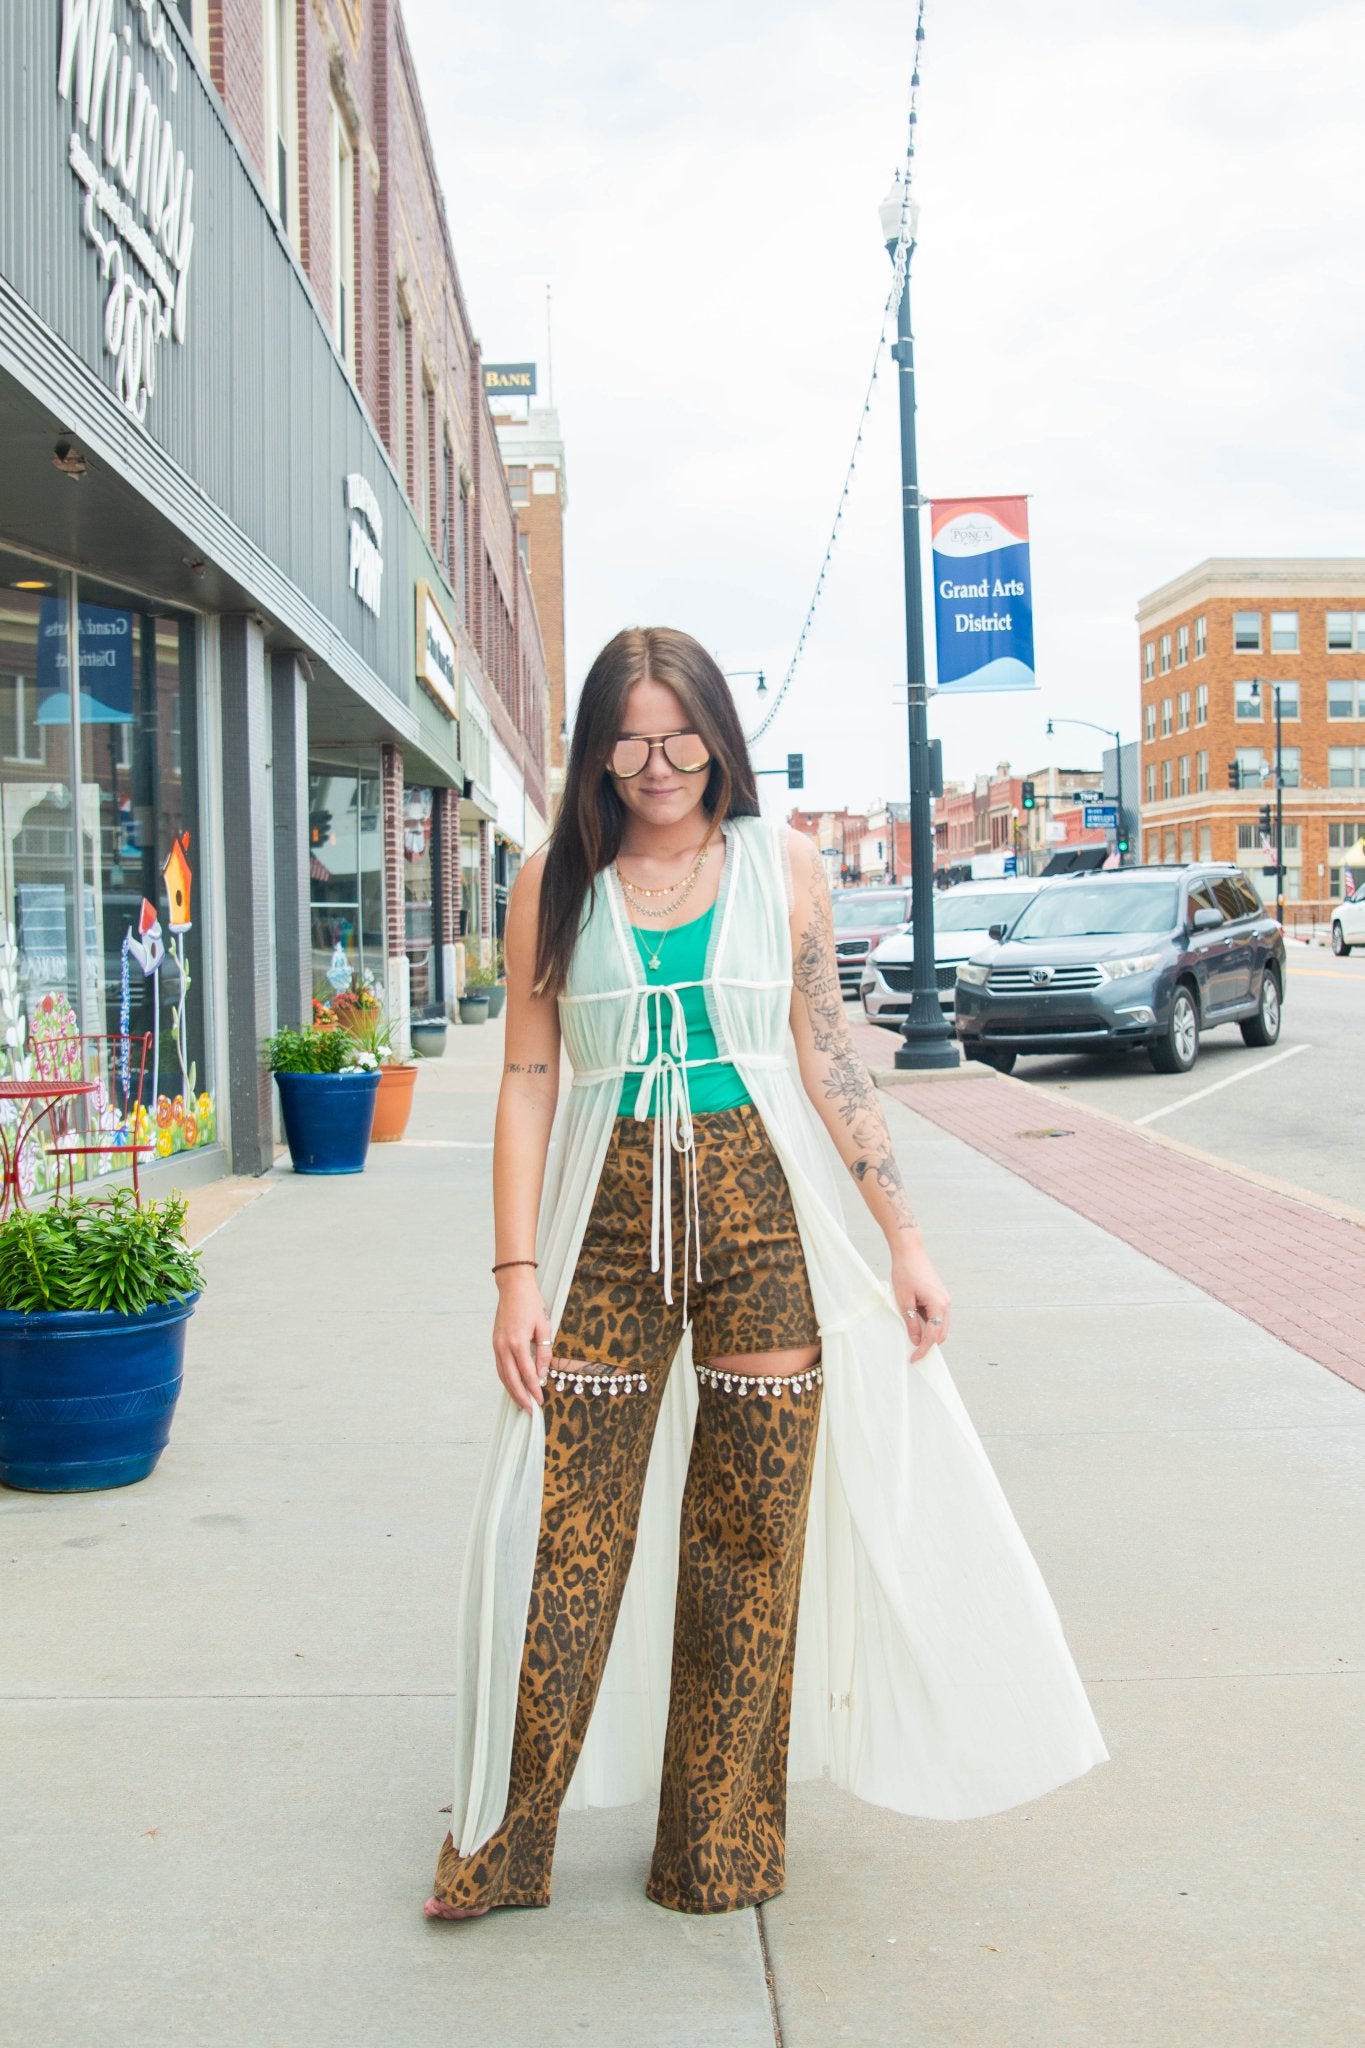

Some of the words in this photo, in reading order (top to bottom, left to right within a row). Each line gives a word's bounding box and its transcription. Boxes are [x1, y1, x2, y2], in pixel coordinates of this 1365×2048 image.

[486, 371, 531, 387] BANK
[940, 579, 989, 598] Grand
[992, 579, 1025, 597] Arts
[955, 612, 1012, 633] District
